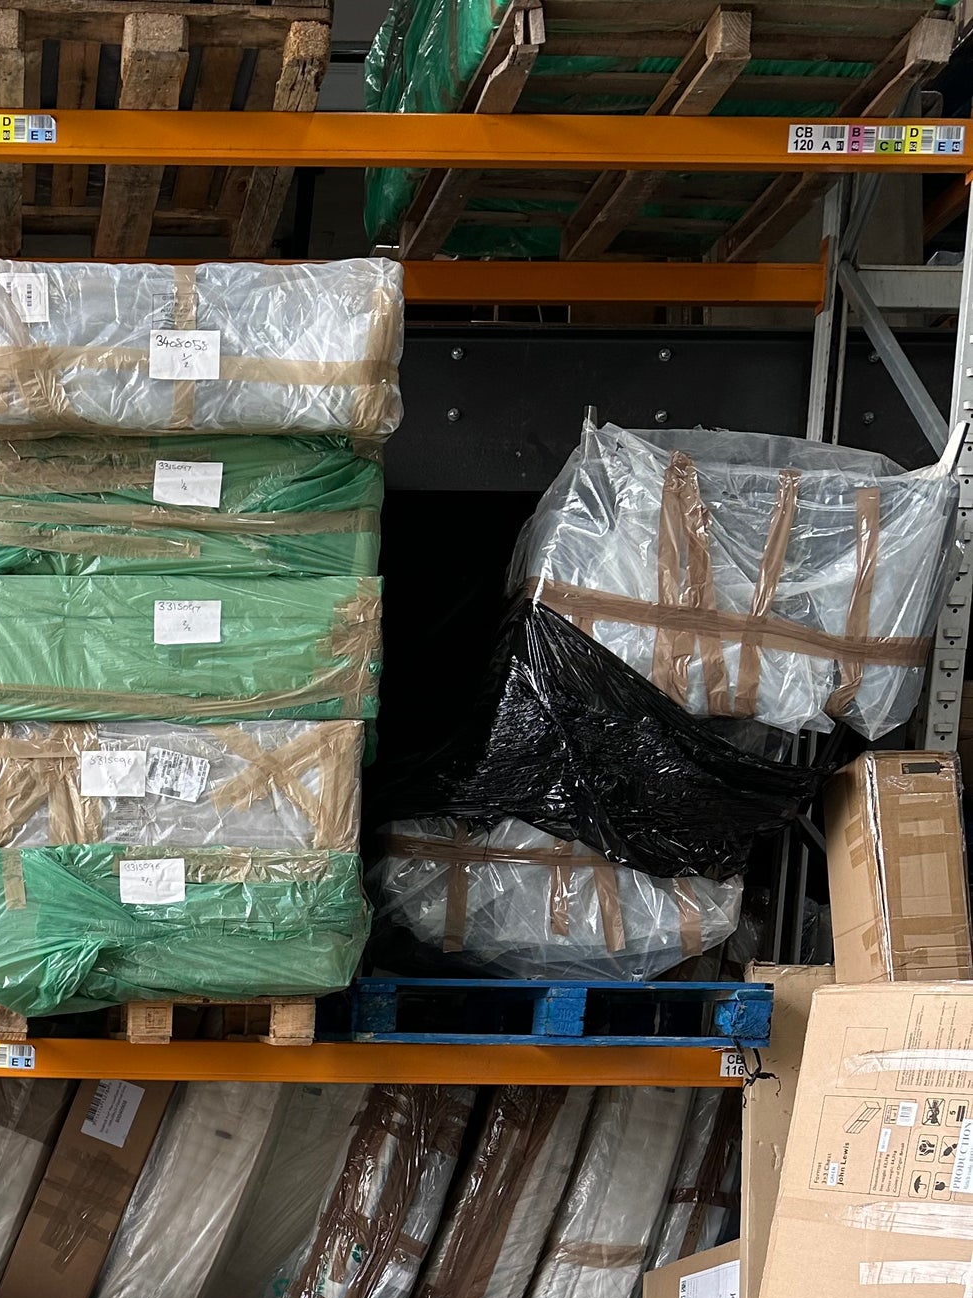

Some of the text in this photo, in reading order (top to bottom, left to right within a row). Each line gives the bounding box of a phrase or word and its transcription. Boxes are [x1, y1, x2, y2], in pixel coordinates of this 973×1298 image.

[3, 117, 11, 127] D
[31, 131, 39, 140] E
[795, 127, 919, 138] CB B D
[793, 140, 814, 151] 120
[822, 142, 831, 151] A
[880, 142, 888, 151] C
[938, 142, 946, 151] E
[12, 1057, 19, 1066] E
[727, 1054, 743, 1064] CB
[726, 1065, 744, 1076] 116
[953, 1123, 972, 1189] PRODUCTION
[837, 1142, 850, 1186] John Lewis
